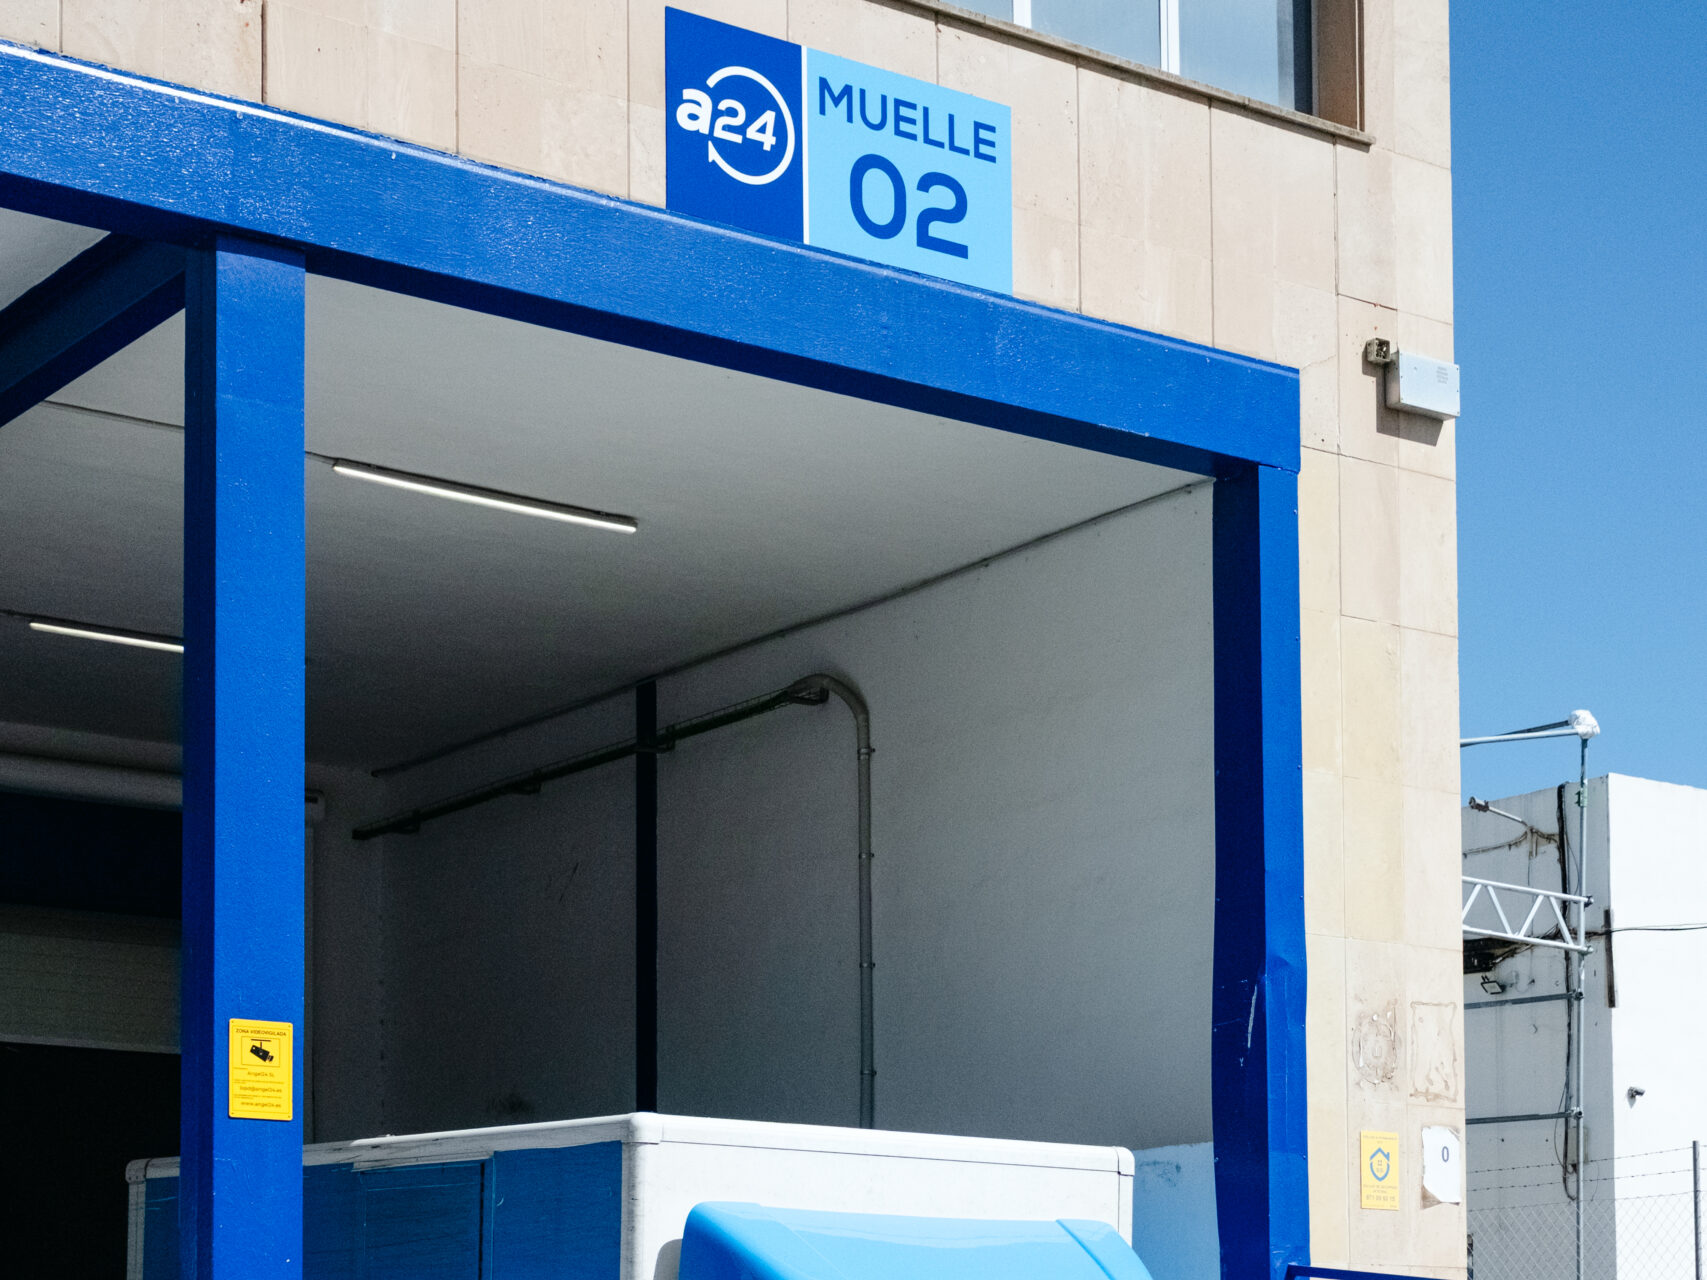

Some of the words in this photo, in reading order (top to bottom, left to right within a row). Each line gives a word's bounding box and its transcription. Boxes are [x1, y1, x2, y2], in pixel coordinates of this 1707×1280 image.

[676, 88, 776, 151] a24
[818, 76, 997, 164] MUELLE
[849, 153, 969, 260] 02
